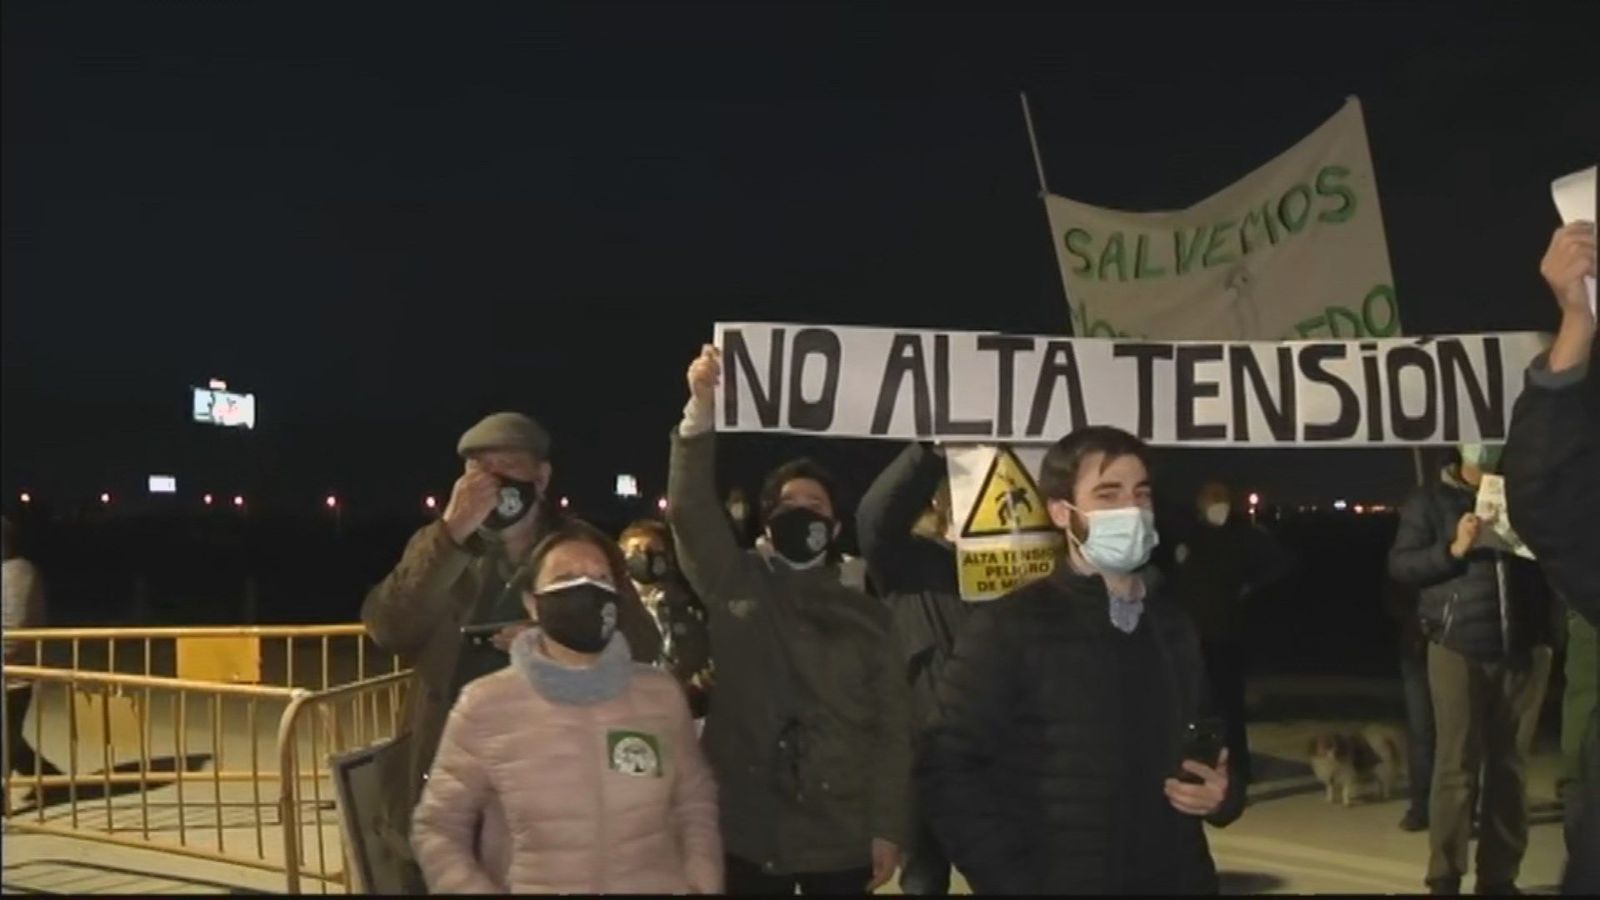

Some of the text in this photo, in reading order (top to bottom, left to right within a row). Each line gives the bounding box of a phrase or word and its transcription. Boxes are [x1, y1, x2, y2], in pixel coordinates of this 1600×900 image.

[1064, 164, 1358, 282] SALVEMOS
[723, 328, 841, 432] NO
[869, 333, 1089, 437] ALTA
[963, 552, 998, 565] ALTA
[976, 580, 996, 593] DE
